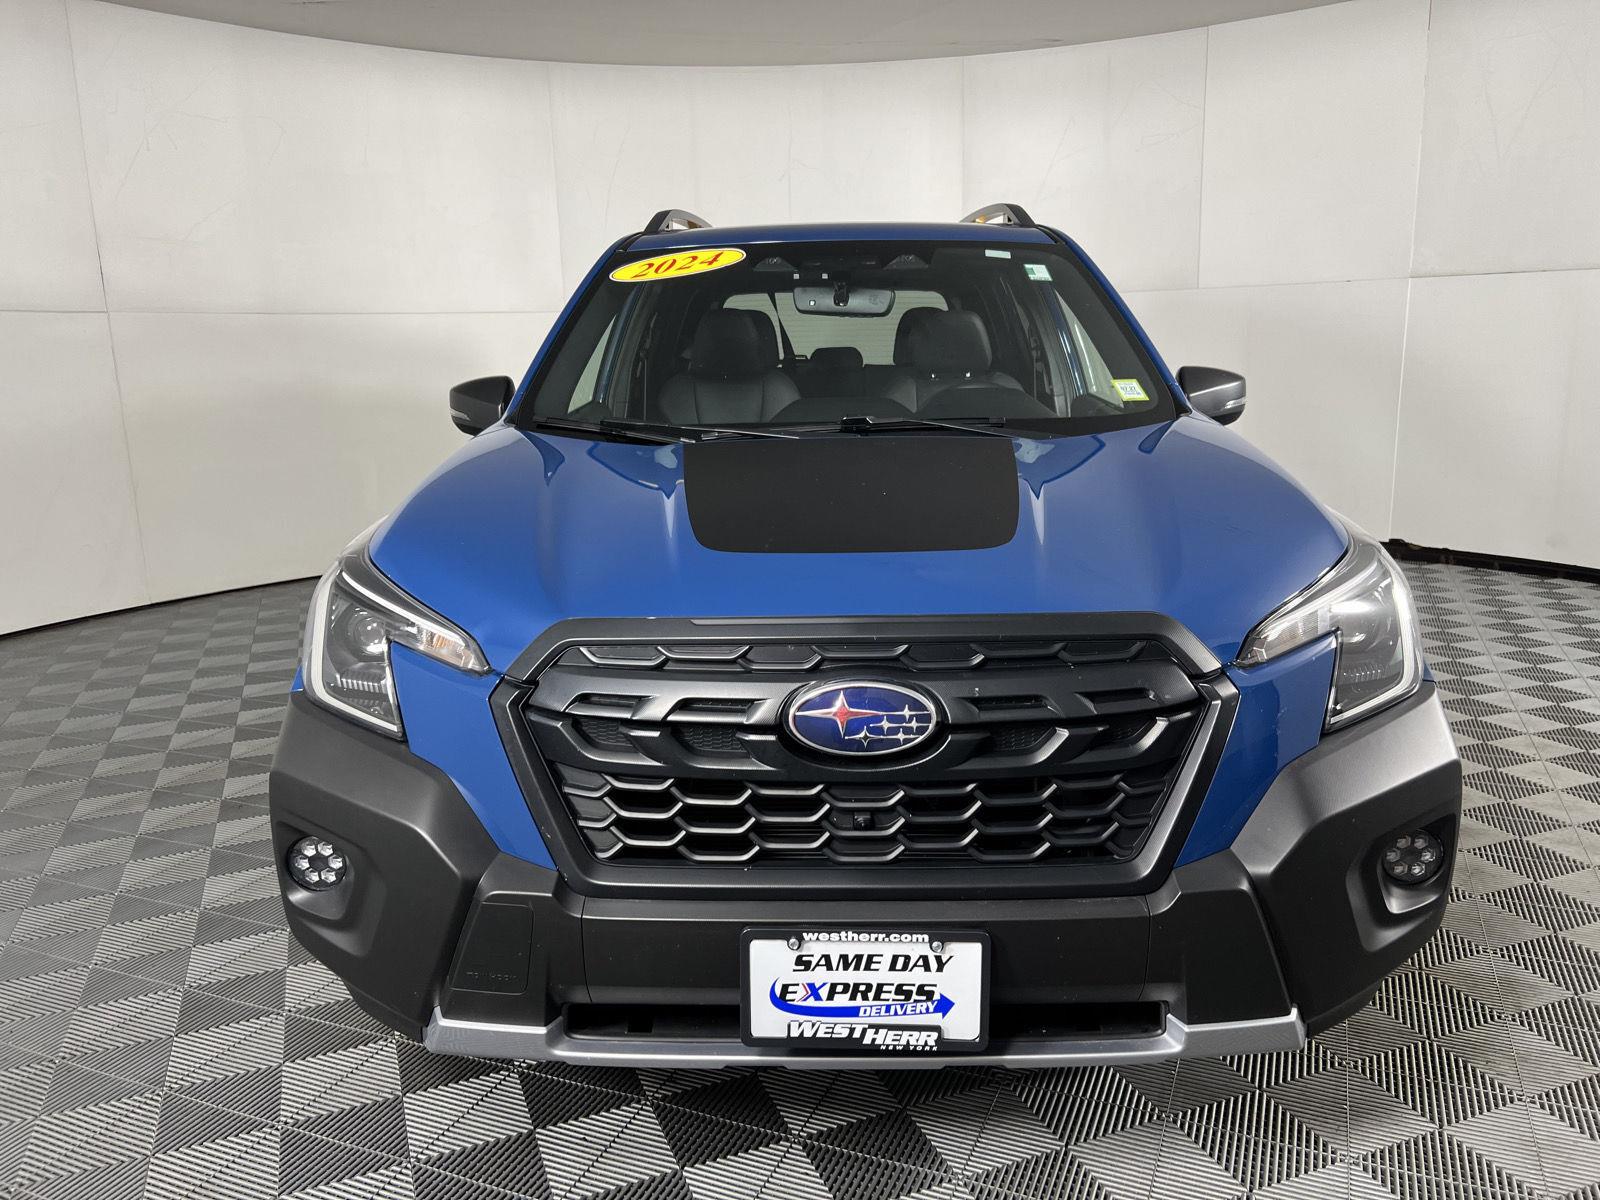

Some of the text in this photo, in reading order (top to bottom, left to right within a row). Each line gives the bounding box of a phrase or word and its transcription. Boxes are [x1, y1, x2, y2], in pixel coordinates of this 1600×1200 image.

[630, 251, 724, 279] 2024
[802, 931, 930, 943] westherr.com
[792, 953, 954, 973] SAME DAY
[778, 982, 938, 1002] EXPRESS
[858, 1001, 938, 1017] DELIVERY
[789, 1020, 939, 1046] WEST HERR
